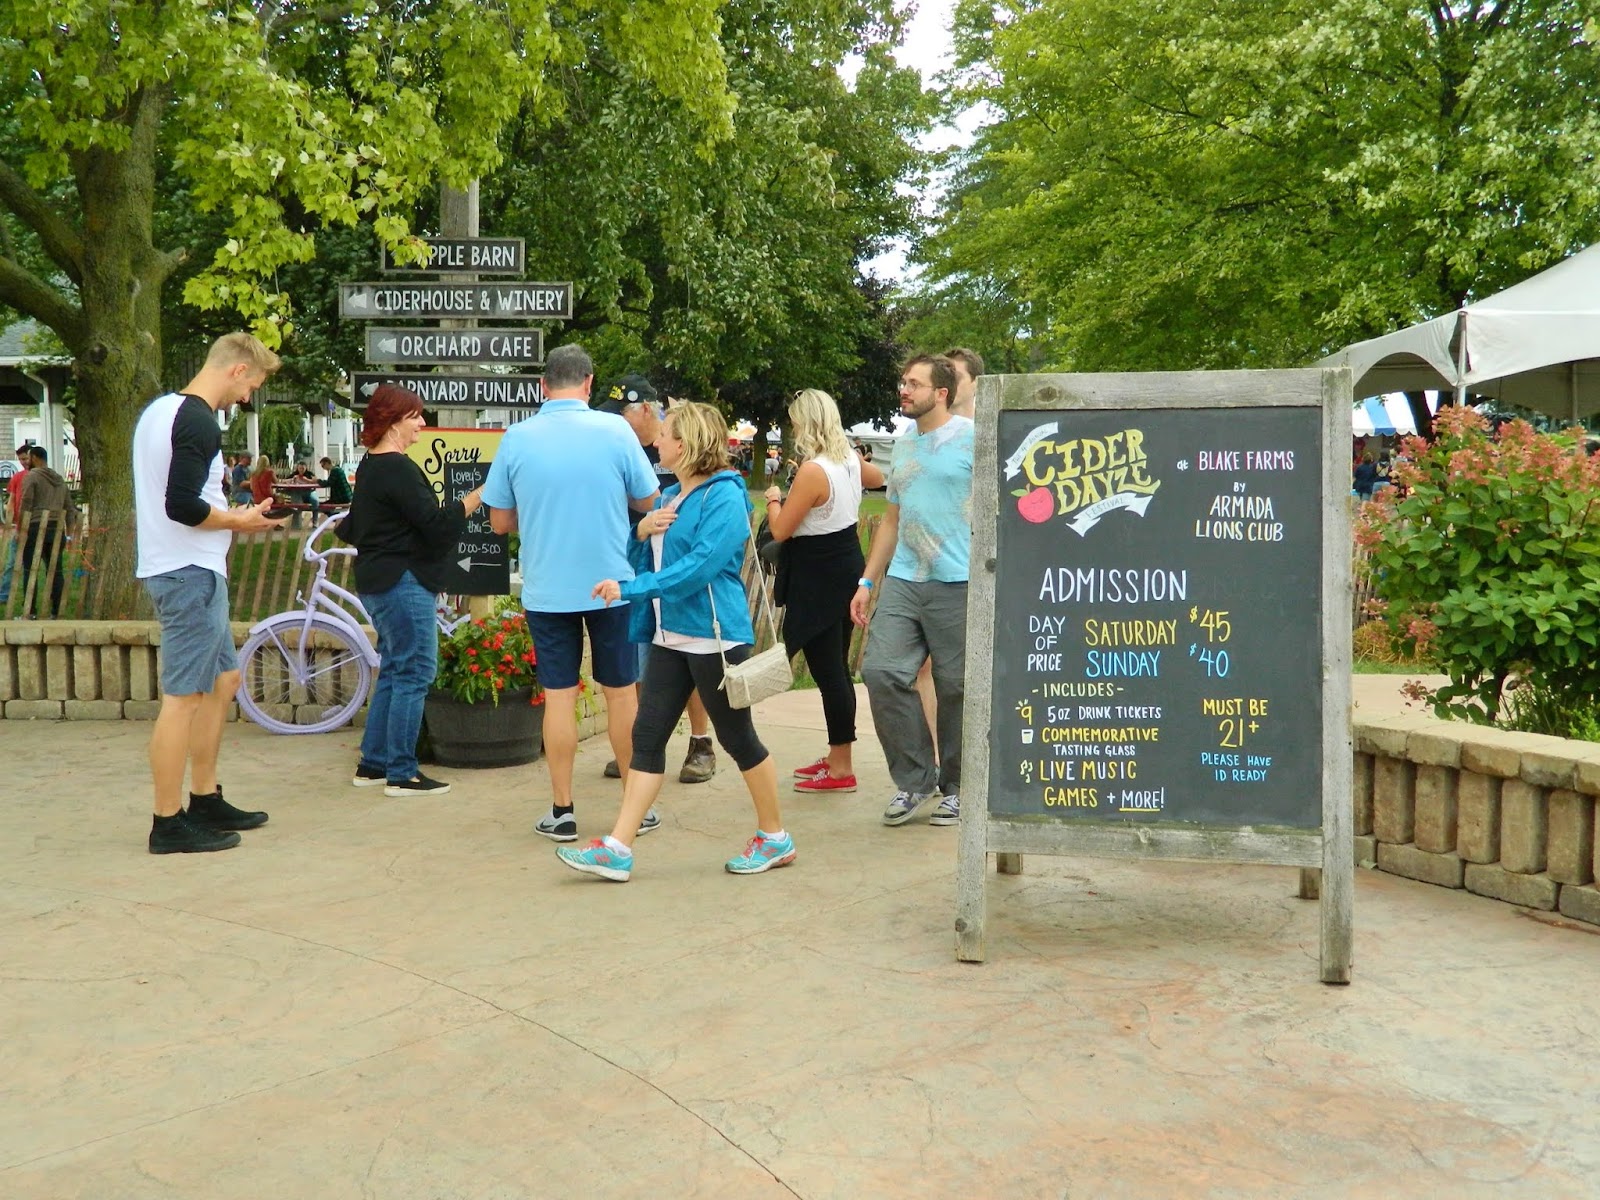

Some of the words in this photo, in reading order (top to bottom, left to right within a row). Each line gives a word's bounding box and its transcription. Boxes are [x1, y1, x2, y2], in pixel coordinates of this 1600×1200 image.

[427, 244, 465, 266] PPLE
[471, 245, 515, 267] BARN
[374, 290, 474, 311] CIDERHOUSE
[480, 290, 490, 311] &
[497, 290, 564, 311] WINERY
[401, 336, 480, 357] ORCHARD
[490, 336, 532, 358] CAFE
[387, 379, 468, 402] RNYARD
[424, 438, 481, 475] Sorry
[1022, 429, 1148, 486] CIDER
[1198, 450, 1240, 471] BLAKE
[1246, 450, 1295, 471] FARMS
[1054, 460, 1161, 515] DAYZE
[1233, 481, 1246, 493] BY
[1085, 498, 1125, 518] FESTIVAL
[1209, 494, 1275, 520] ARMADA
[1195, 519, 1244, 541] LIONS
[1247, 521, 1284, 542] CLUB
[1038, 567, 1187, 604] ADMISSION
[1029, 615, 1066, 634] DAY
[1085, 618, 1177, 647] SATURDAY
[1189, 606, 1231, 643] $45
[1035, 635, 1058, 651] OF
[1027, 653, 1063, 672] PRICE
[1086, 650, 1161, 678] SUNDAY
[1189, 643, 1229, 678] $40
[1078, 705, 1112, 720] DRINK
[1115, 705, 1163, 720] TICKETS
[1203, 698, 1243, 716] MUST
[1250, 698, 1268, 716] BE
[1042, 727, 1159, 743] COMMEMORATIVE
[1219, 718, 1260, 748] 21+
[1053, 743, 1100, 757] TASTING
[1105, 744, 1136, 758] GLASS
[1201, 752, 1240, 766] PLEASE
[1247, 755, 1272, 767] HAVE
[1039, 759, 1075, 781] LIVE
[1082, 760, 1137, 780] MUSIC
[1215, 769, 1226, 782] ID
[1232, 769, 1267, 782] READY
[1044, 786, 1098, 808] GAMES
[1106, 792, 1116, 804] +
[1121, 787, 1165, 809] MORE!
